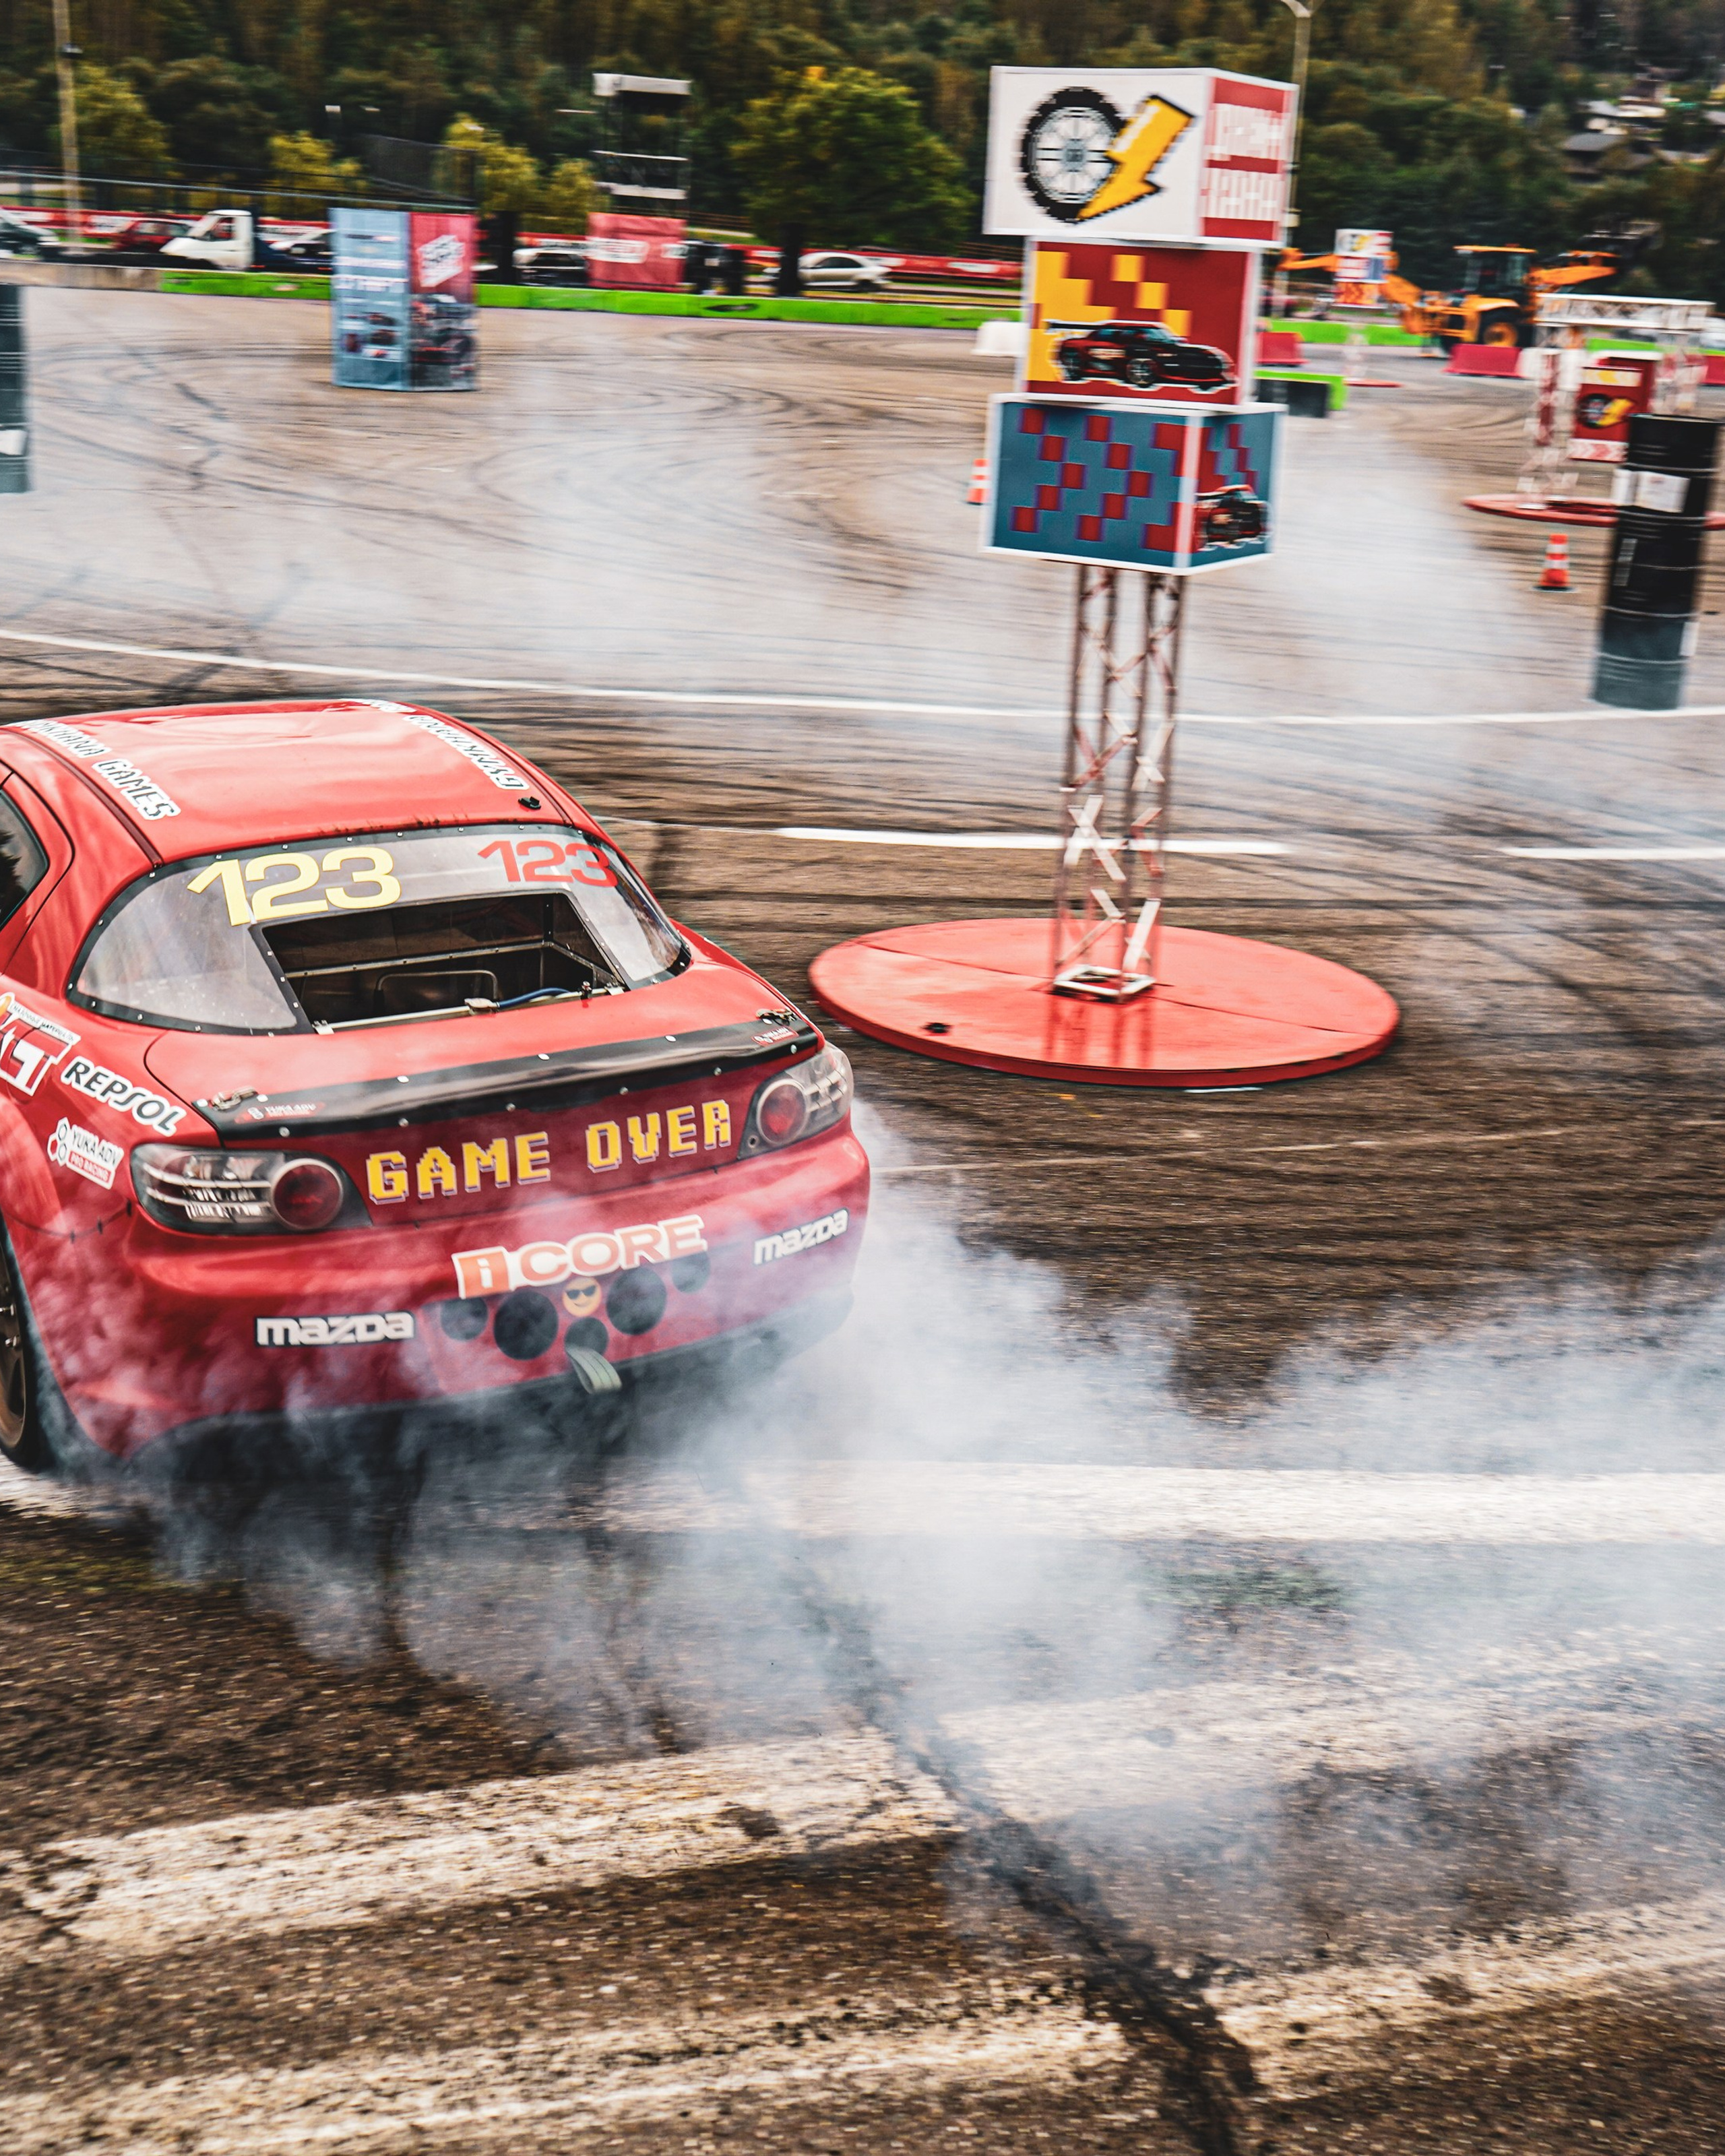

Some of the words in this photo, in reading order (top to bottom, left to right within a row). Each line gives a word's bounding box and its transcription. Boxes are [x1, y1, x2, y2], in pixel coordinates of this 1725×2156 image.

[99, 761, 174, 817] GAMES
[187, 847, 401, 926] 123
[477, 840, 618, 887] 123
[65, 1061, 179, 1131] REPSOL
[366, 1131, 551, 1205] GAME
[586, 1100, 731, 1173] OVER
